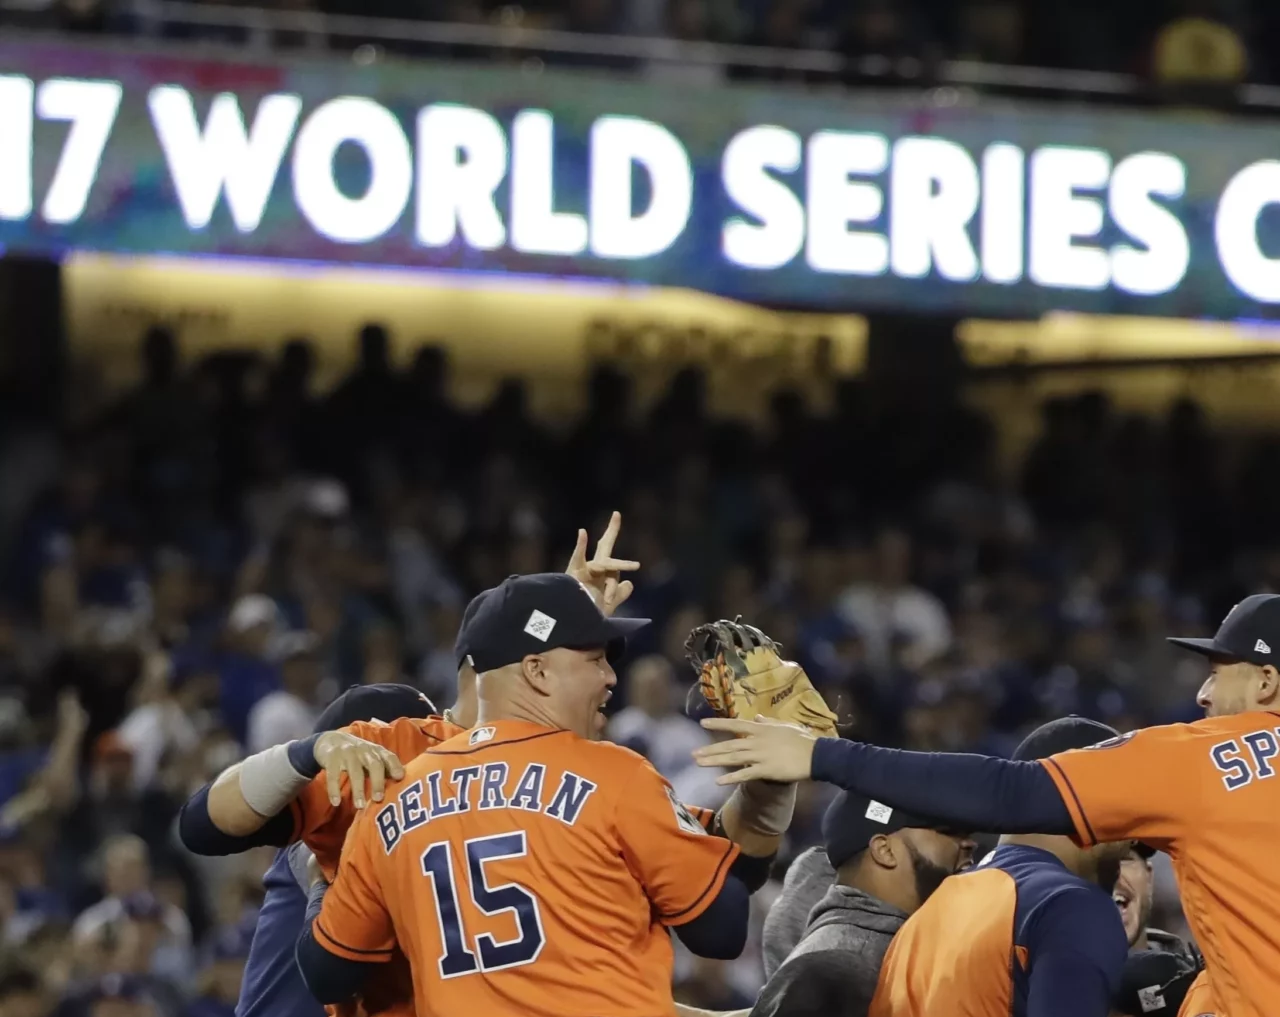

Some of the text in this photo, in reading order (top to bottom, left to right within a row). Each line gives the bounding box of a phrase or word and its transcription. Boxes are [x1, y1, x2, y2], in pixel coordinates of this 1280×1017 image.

[0, 74, 122, 224] 17
[148, 84, 693, 260] WORLD
[721, 124, 1190, 294] SERIES
[375, 761, 598, 856] BELTRAN
[419, 829, 546, 980] 15
